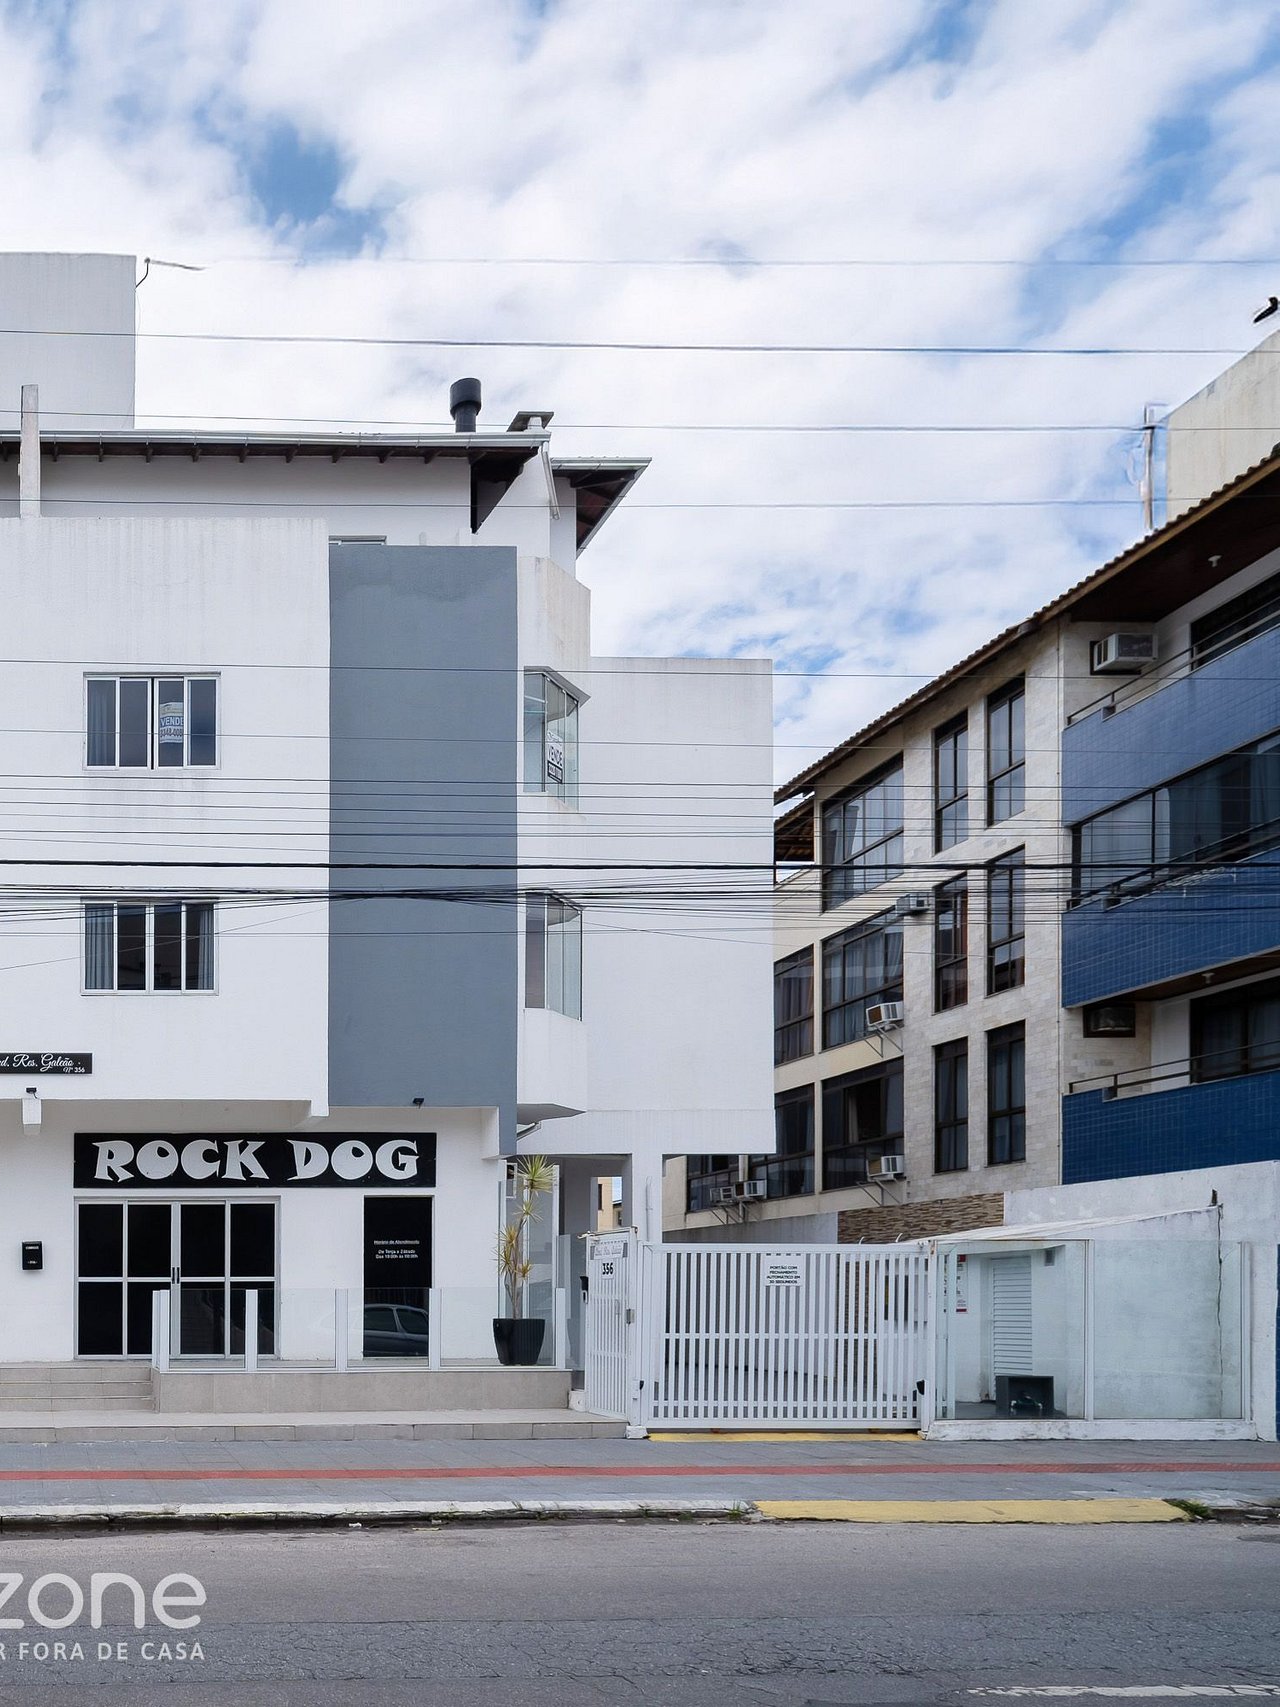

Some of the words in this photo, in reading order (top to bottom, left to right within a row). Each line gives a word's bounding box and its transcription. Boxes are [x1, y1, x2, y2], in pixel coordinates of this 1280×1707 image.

[12, 1053, 38, 1068] Res.
[40, 1053, 74, 1072] Galeão
[91, 1139, 270, 1183] ROCK
[287, 1139, 420, 1182] DOG
[602, 1262, 614, 1275] 356
